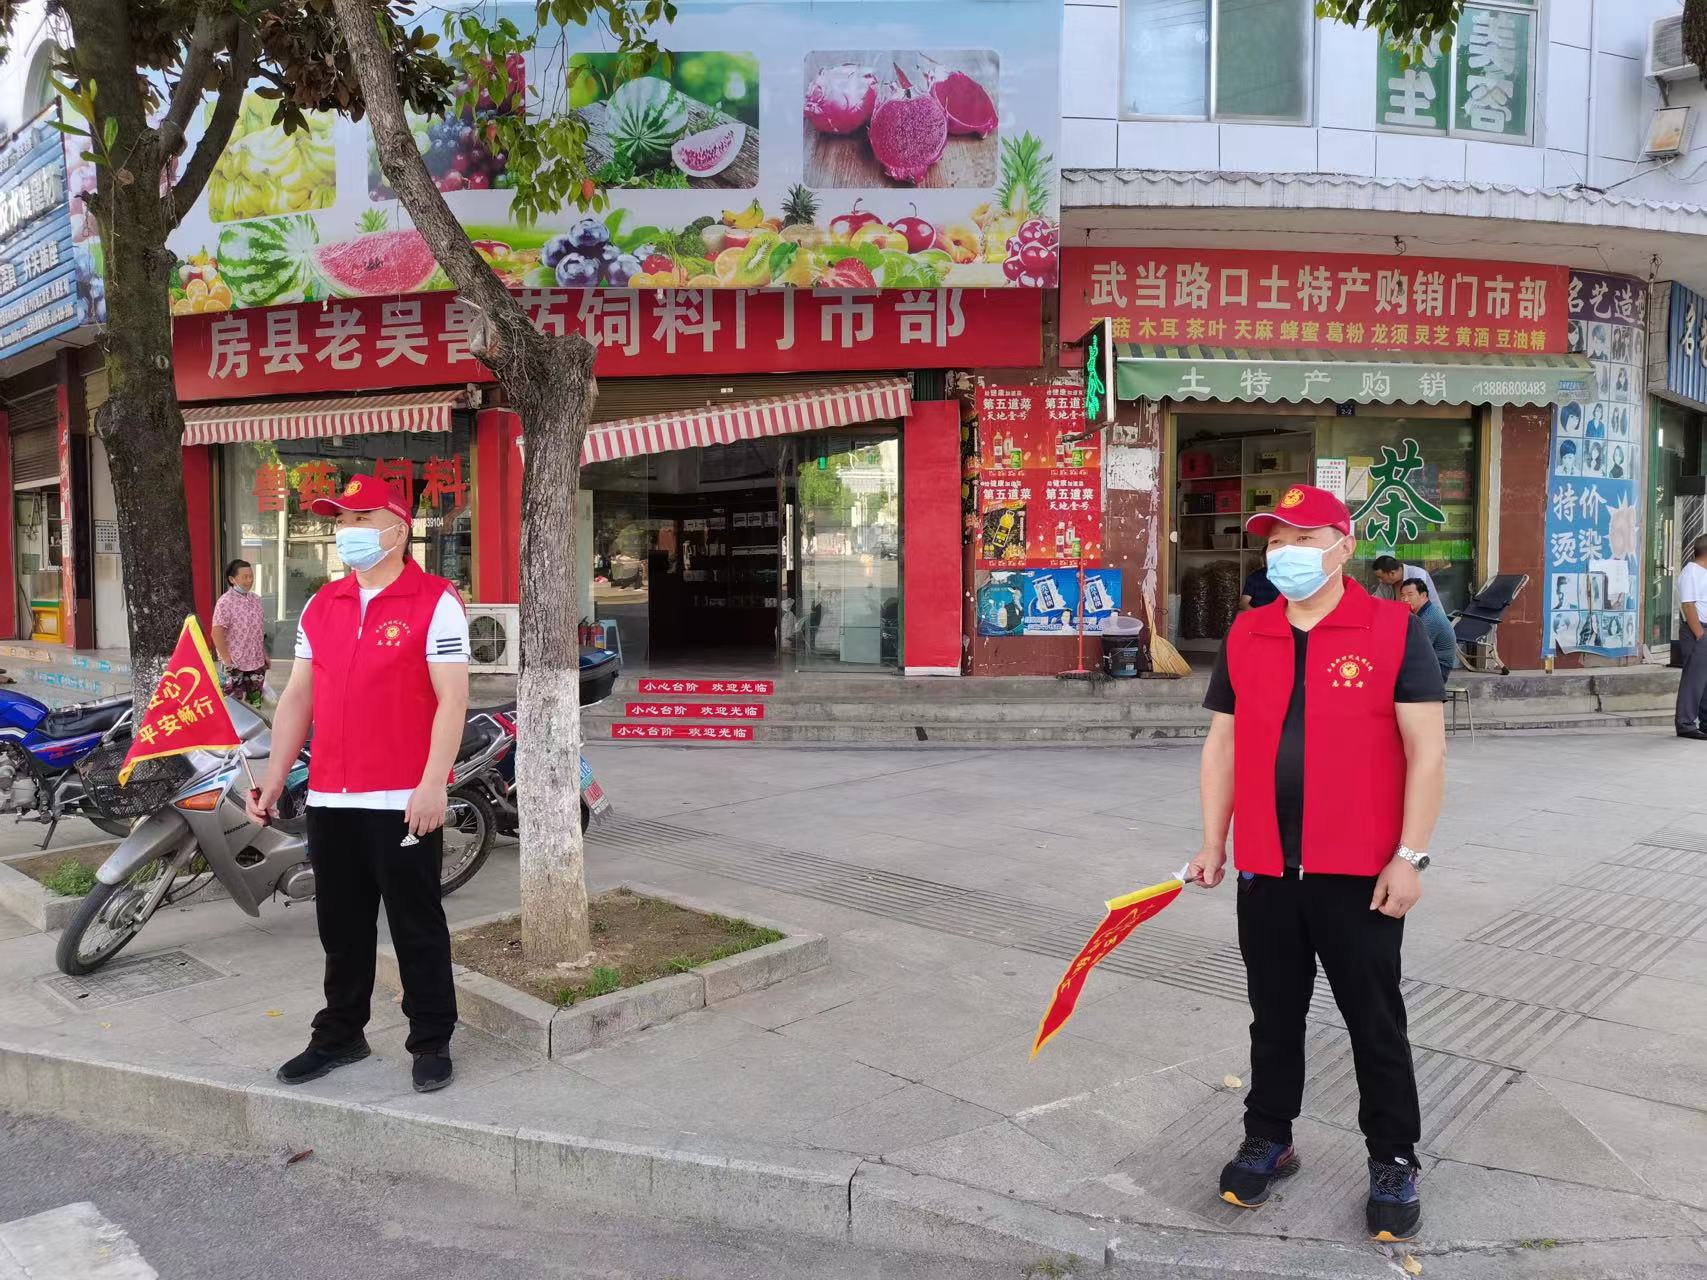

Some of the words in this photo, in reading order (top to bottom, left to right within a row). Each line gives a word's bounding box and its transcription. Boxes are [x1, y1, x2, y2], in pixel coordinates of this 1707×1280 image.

[1091, 260, 1547, 322] 武当路口土特产购销门市部
[1138, 317, 1180, 339] 木耳
[1186, 318, 1227, 340] 茶叶
[1234, 319, 1273, 341] 天麻
[1280, 320, 1320, 342] 蜂蜜
[1326, 321, 1365, 344] 葛粉
[1371, 323, 1408, 344] 龙须
[1414, 325, 1450, 346] 灵芝
[1456, 326, 1490, 348] 黄酒
[1495, 328, 1547, 351] 豆油精
[1177, 366, 1447, 397] 土特产购销
[1479, 381, 1546, 396] 13886808483
[983, 398, 1032, 411] 第五道菜
[1045, 398, 1086, 410] 第五道
[983, 488, 1032, 500] 第五道菜
[1045, 488, 1094, 500] 第五道菜
[1350, 438, 1446, 547] 茶
[1553, 483, 1607, 525] 特价
[1551, 528, 1603, 567] 烫染
[644, 682, 699, 692] 小心台阶
[711, 682, 768, 693] 欢迎光临
[632, 705, 687, 715] 小心台阶
[700, 706, 758, 716] 欢迎光临
[139, 695, 215, 745] 平安畅行
[617, 726, 674, 736] 小心台阶
[688, 727, 747, 738] 欢迎光临
